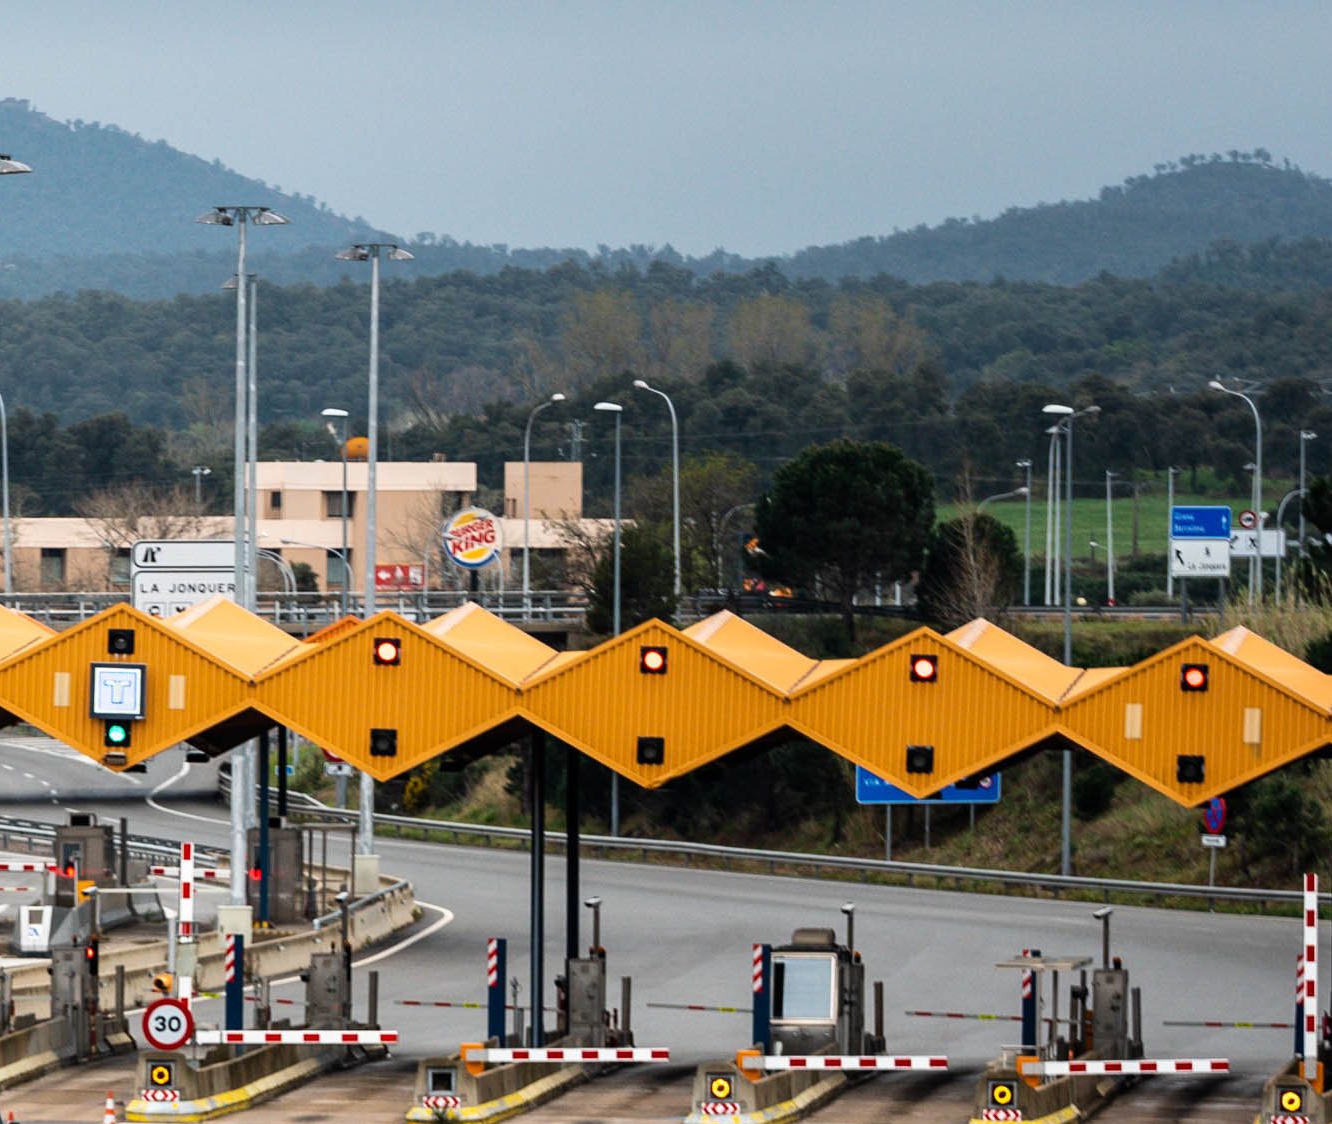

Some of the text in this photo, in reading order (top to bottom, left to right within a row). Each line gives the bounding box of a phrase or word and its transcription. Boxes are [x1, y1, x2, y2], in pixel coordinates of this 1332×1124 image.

[449, 519, 493, 537] BURGER
[450, 530, 495, 556] KING
[140, 583, 236, 593] LA JONQUER
[155, 1015, 181, 1032] 30
